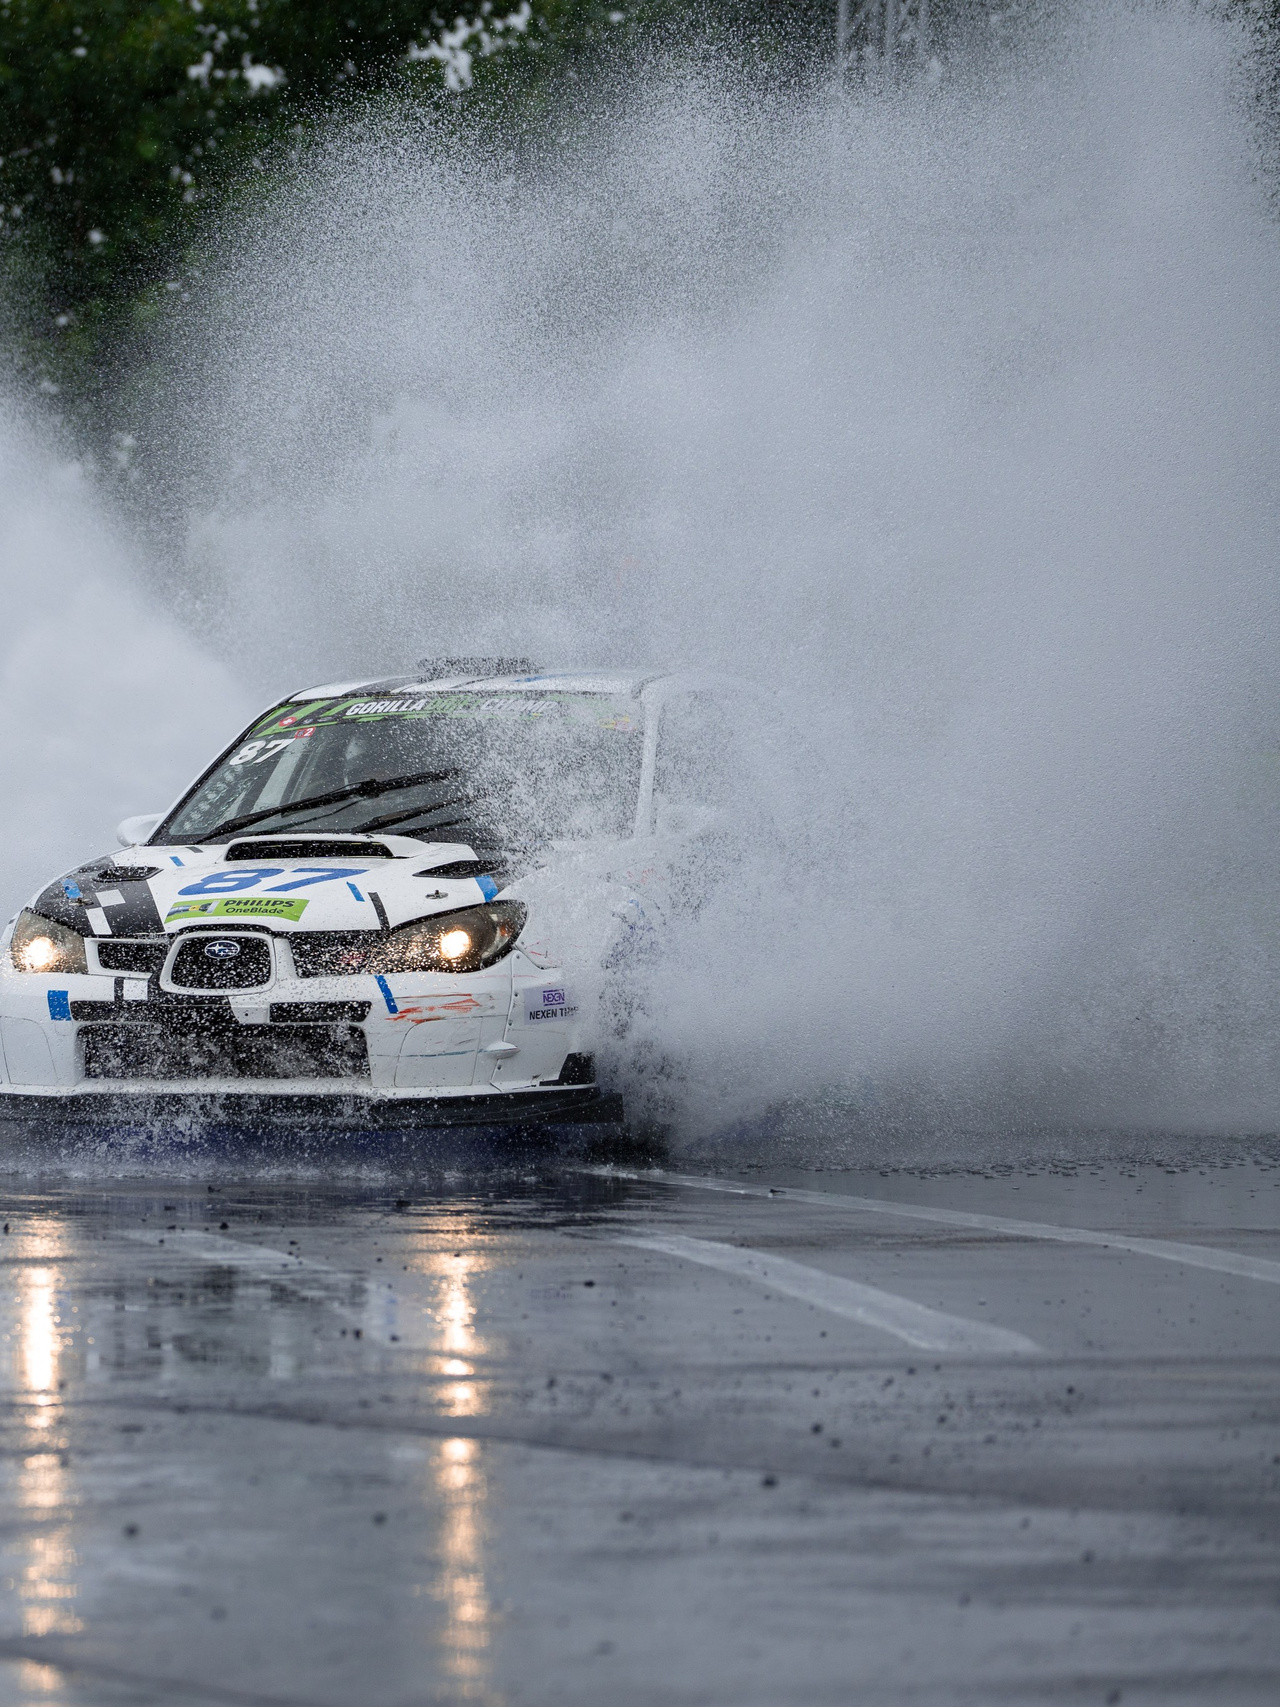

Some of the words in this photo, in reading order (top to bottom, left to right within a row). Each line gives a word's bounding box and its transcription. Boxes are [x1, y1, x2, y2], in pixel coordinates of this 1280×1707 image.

[345, 699, 425, 716] GORILLA
[303, 727, 313, 737] 2
[229, 737, 295, 766] 87
[178, 867, 370, 896] 87
[223, 899, 295, 908] PHILIPS
[225, 906, 284, 915] OneBlade
[543, 991, 565, 1004] NEXEN
[529, 1008, 557, 1020] NEXEN
